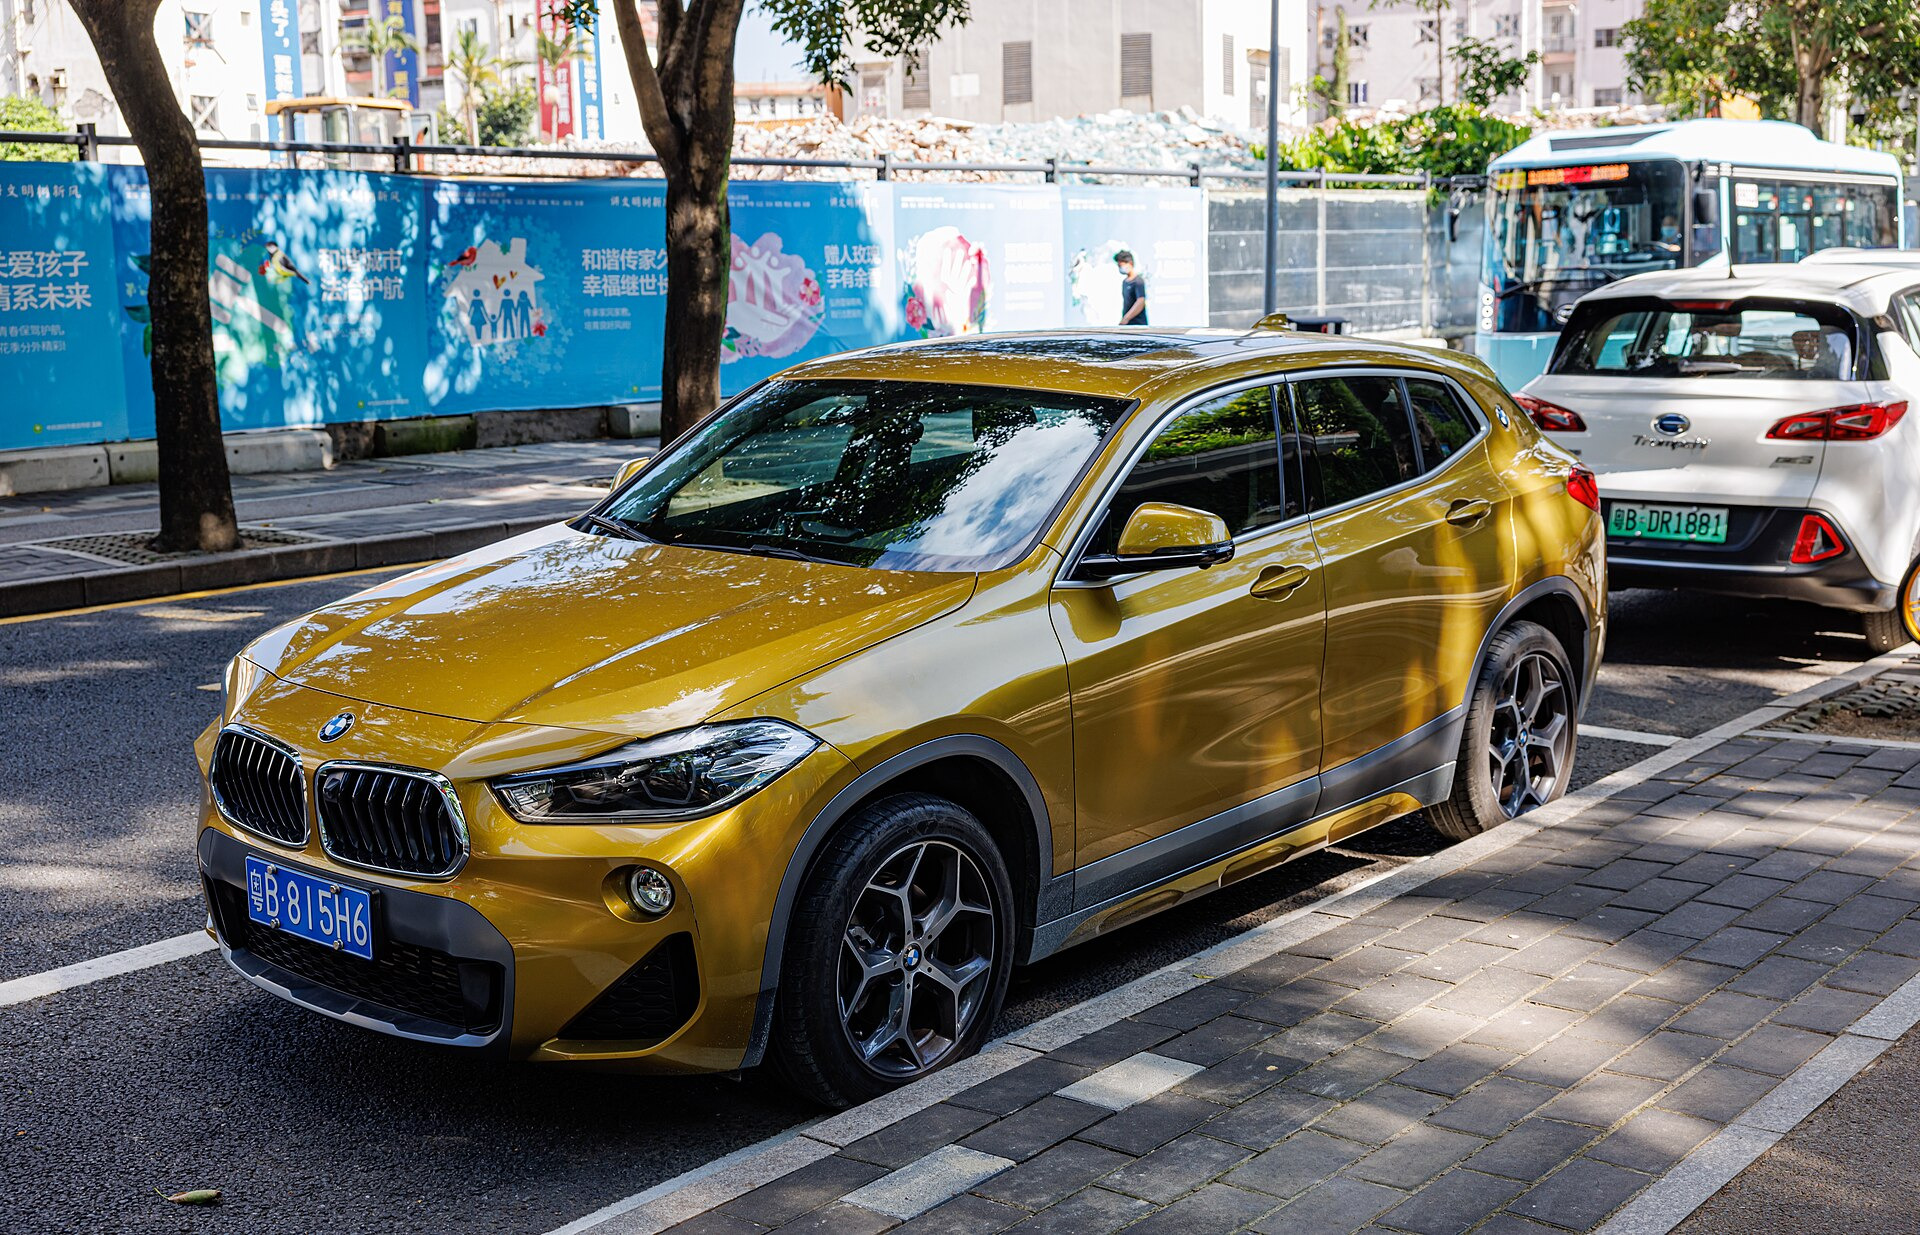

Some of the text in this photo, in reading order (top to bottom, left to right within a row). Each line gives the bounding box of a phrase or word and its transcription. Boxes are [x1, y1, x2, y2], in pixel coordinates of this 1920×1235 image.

[0, 183, 82, 199] 文明树新风
[318, 247, 403, 274] 和谐城市
[320, 275, 405, 302] 法治护航
